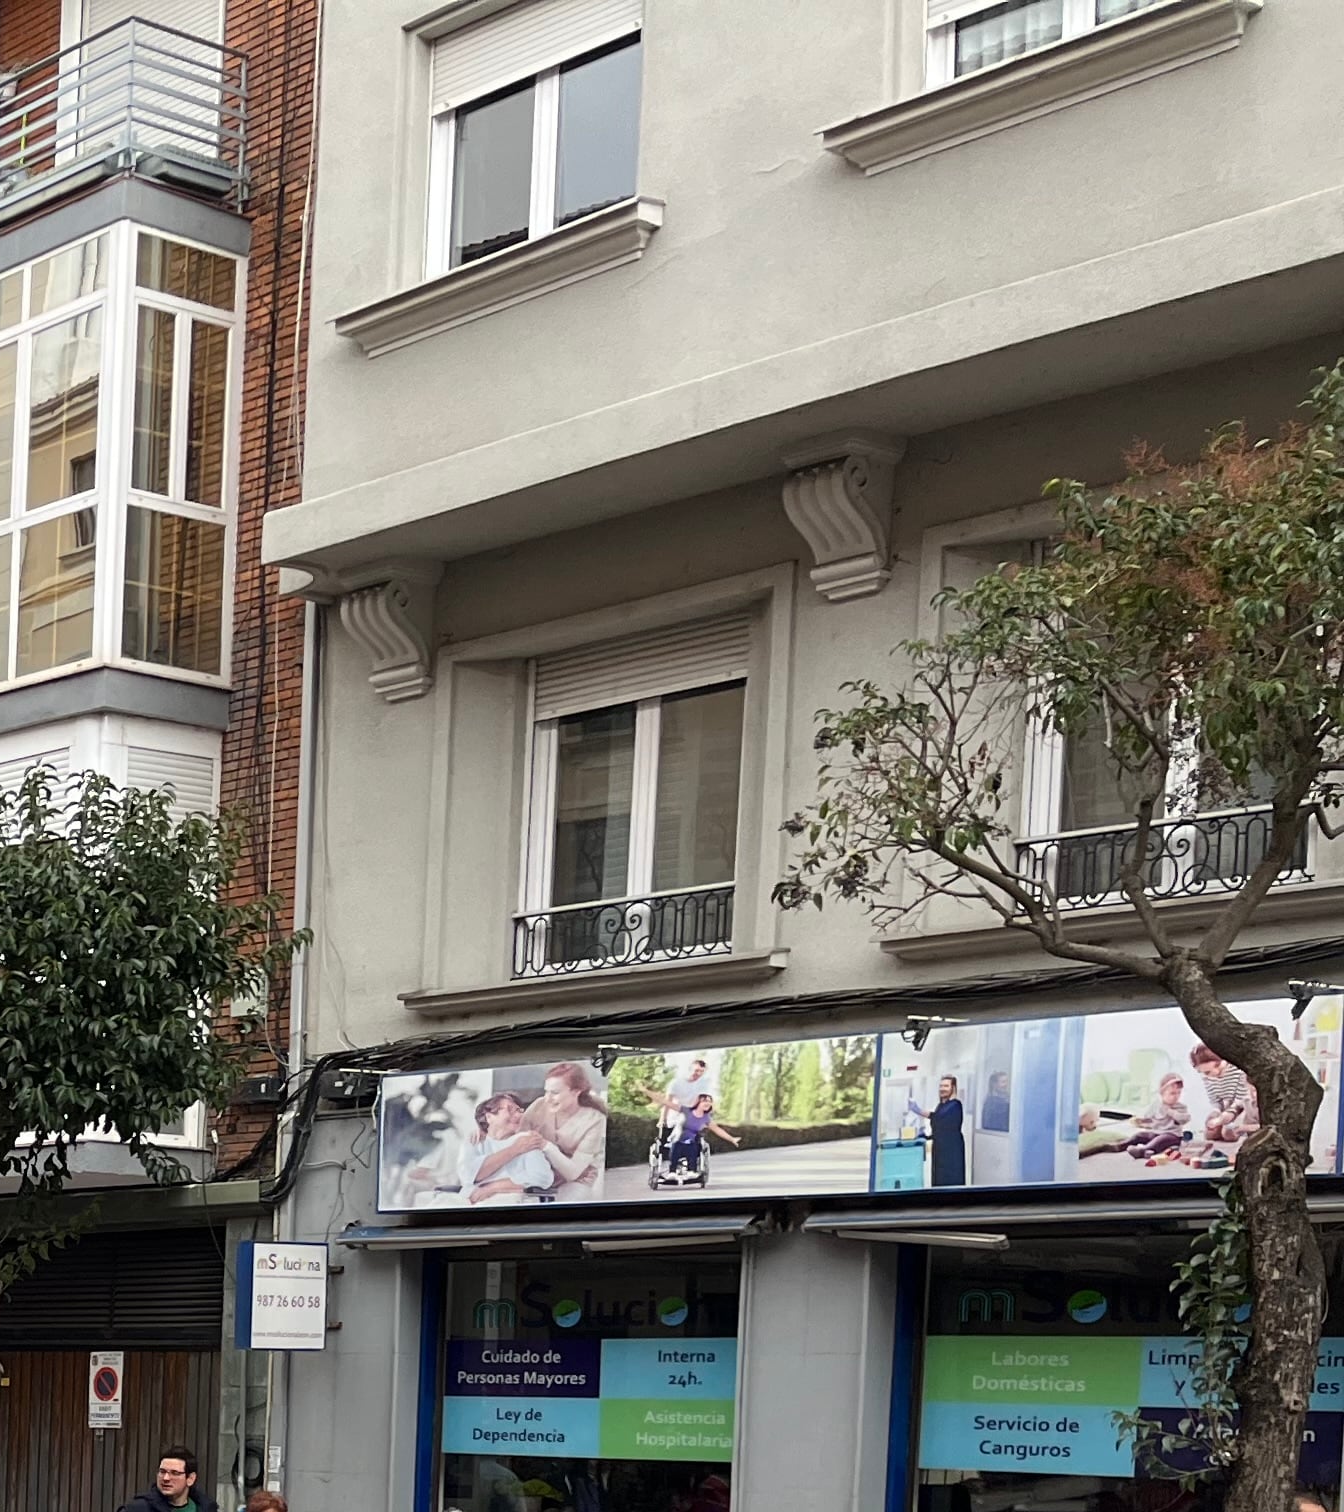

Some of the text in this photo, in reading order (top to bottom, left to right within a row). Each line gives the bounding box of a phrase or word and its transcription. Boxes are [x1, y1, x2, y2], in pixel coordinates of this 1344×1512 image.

[256, 1294, 321, 1309] 987 26 60 58
[481, 1350, 561, 1364] Cuidado de
[657, 1349, 716, 1364] Interna
[991, 1350, 1071, 1367] Labores
[457, 1371, 587, 1389] Personas Mayores
[668, 1371, 703, 1388] 24h.
[972, 1374, 1087, 1393] Domésticas
[1175, 1379, 1186, 1396] y
[496, 1407, 543, 1424] Ley de
[643, 1410, 726, 1426] Asistencia
[973, 1415, 1080, 1434] Servicio de
[472, 1428, 565, 1445] Dependencia
[635, 1432, 733, 1450] Hospitalaria
[978, 1440, 1072, 1461] Canguros
